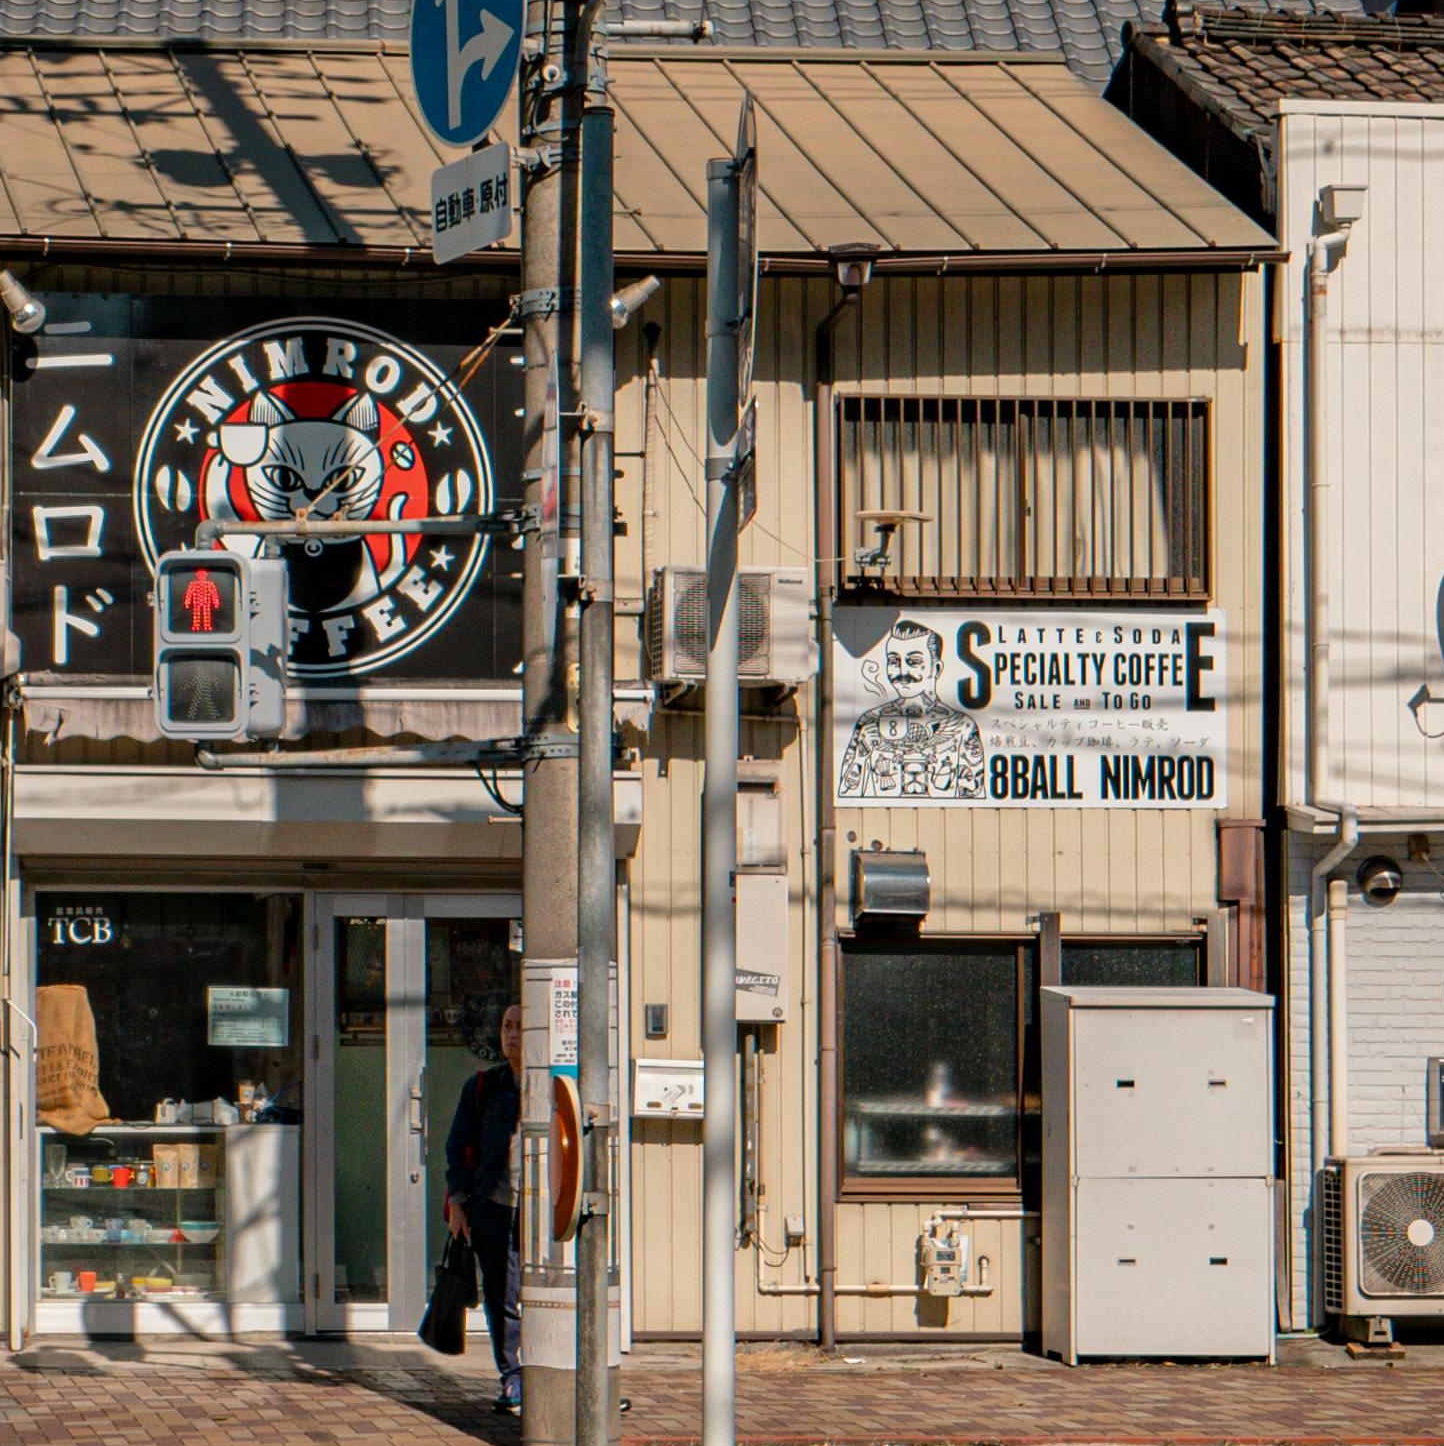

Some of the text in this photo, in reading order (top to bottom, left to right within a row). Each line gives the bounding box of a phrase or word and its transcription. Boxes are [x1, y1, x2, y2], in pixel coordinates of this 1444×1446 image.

[435, 171, 508, 233] 自動車・原付
[186, 336, 440, 425] NIMROD
[26, 320, 113, 665] ニムロド
[287, 563, 444, 658] FFEE
[998, 625, 1085, 645] LATTE
[1114, 625, 1181, 645] SODA
[957, 620, 1216, 712] SPECIALTY COFFEE
[990, 717, 1170, 732] スペシャルティコーヒー販売
[1015, 691, 1061, 711] SALE
[989, 755, 1215, 800] 8BALL NIMROD
[47, 916, 114, 945] TCB
